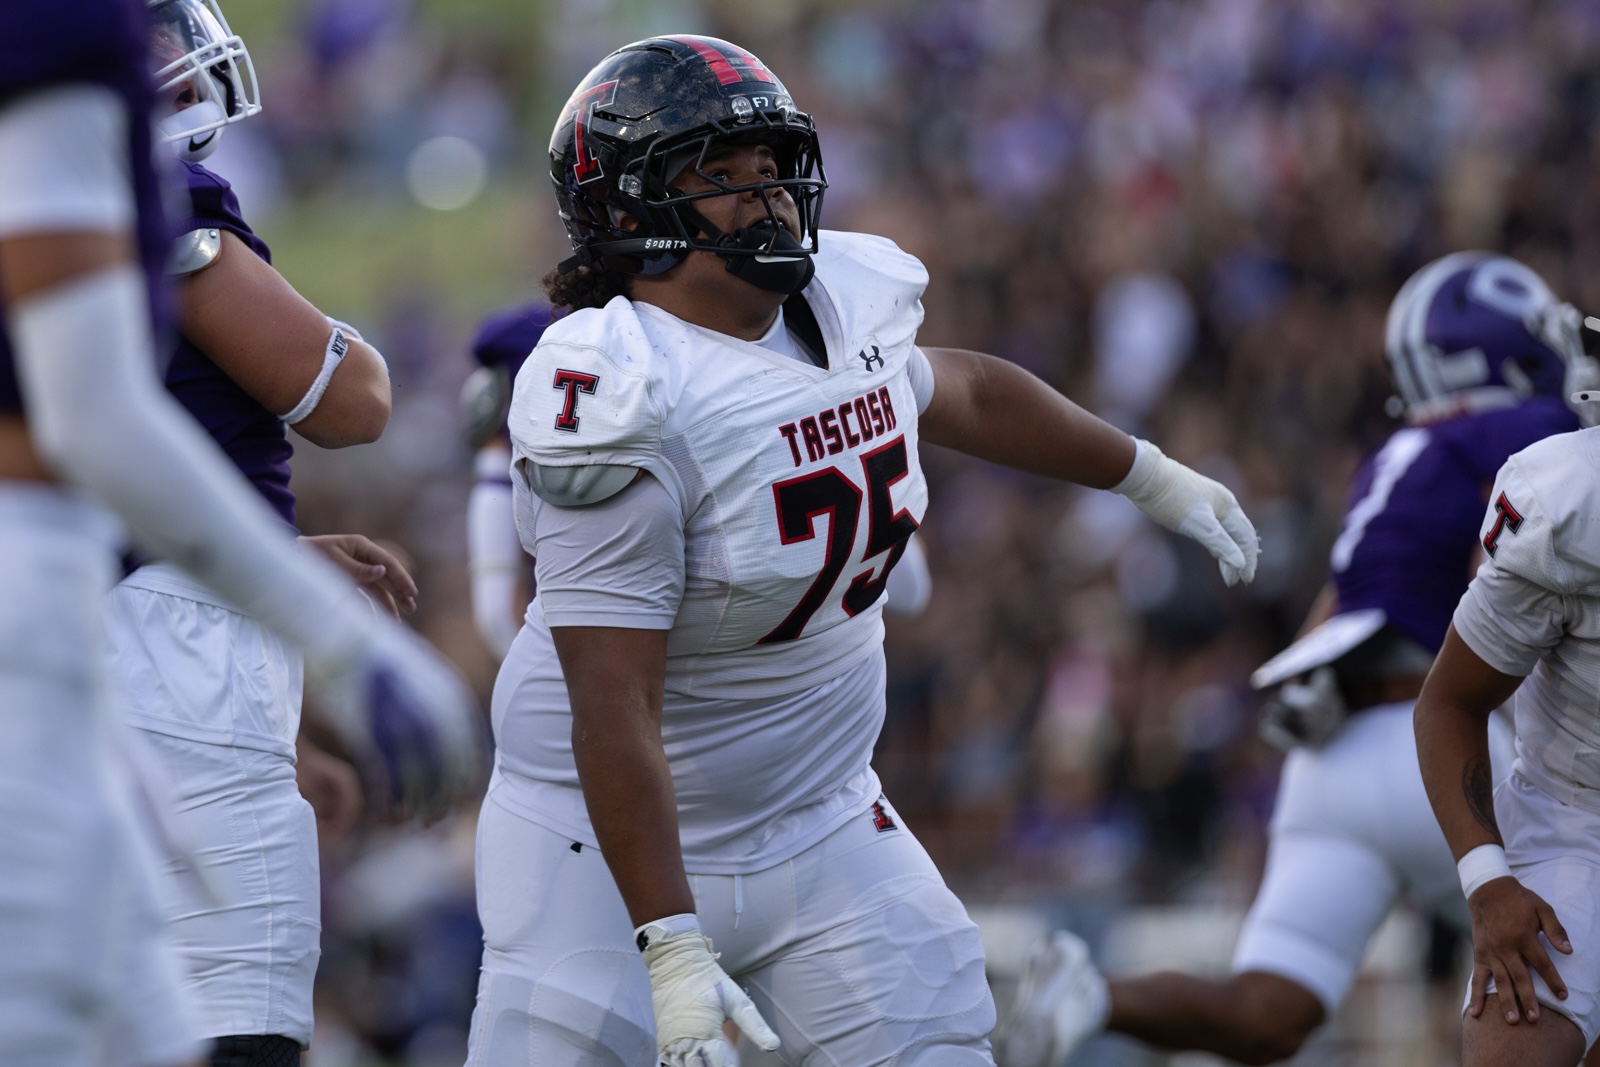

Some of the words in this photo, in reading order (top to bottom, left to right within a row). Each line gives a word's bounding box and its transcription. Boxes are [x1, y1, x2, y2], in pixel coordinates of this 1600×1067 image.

[561, 79, 619, 185] T
[752, 97, 769, 108] F7
[553, 368, 600, 433] T
[778, 386, 897, 468] TASCOSA
[754, 433, 920, 645] 75
[1483, 490, 1524, 559] T
